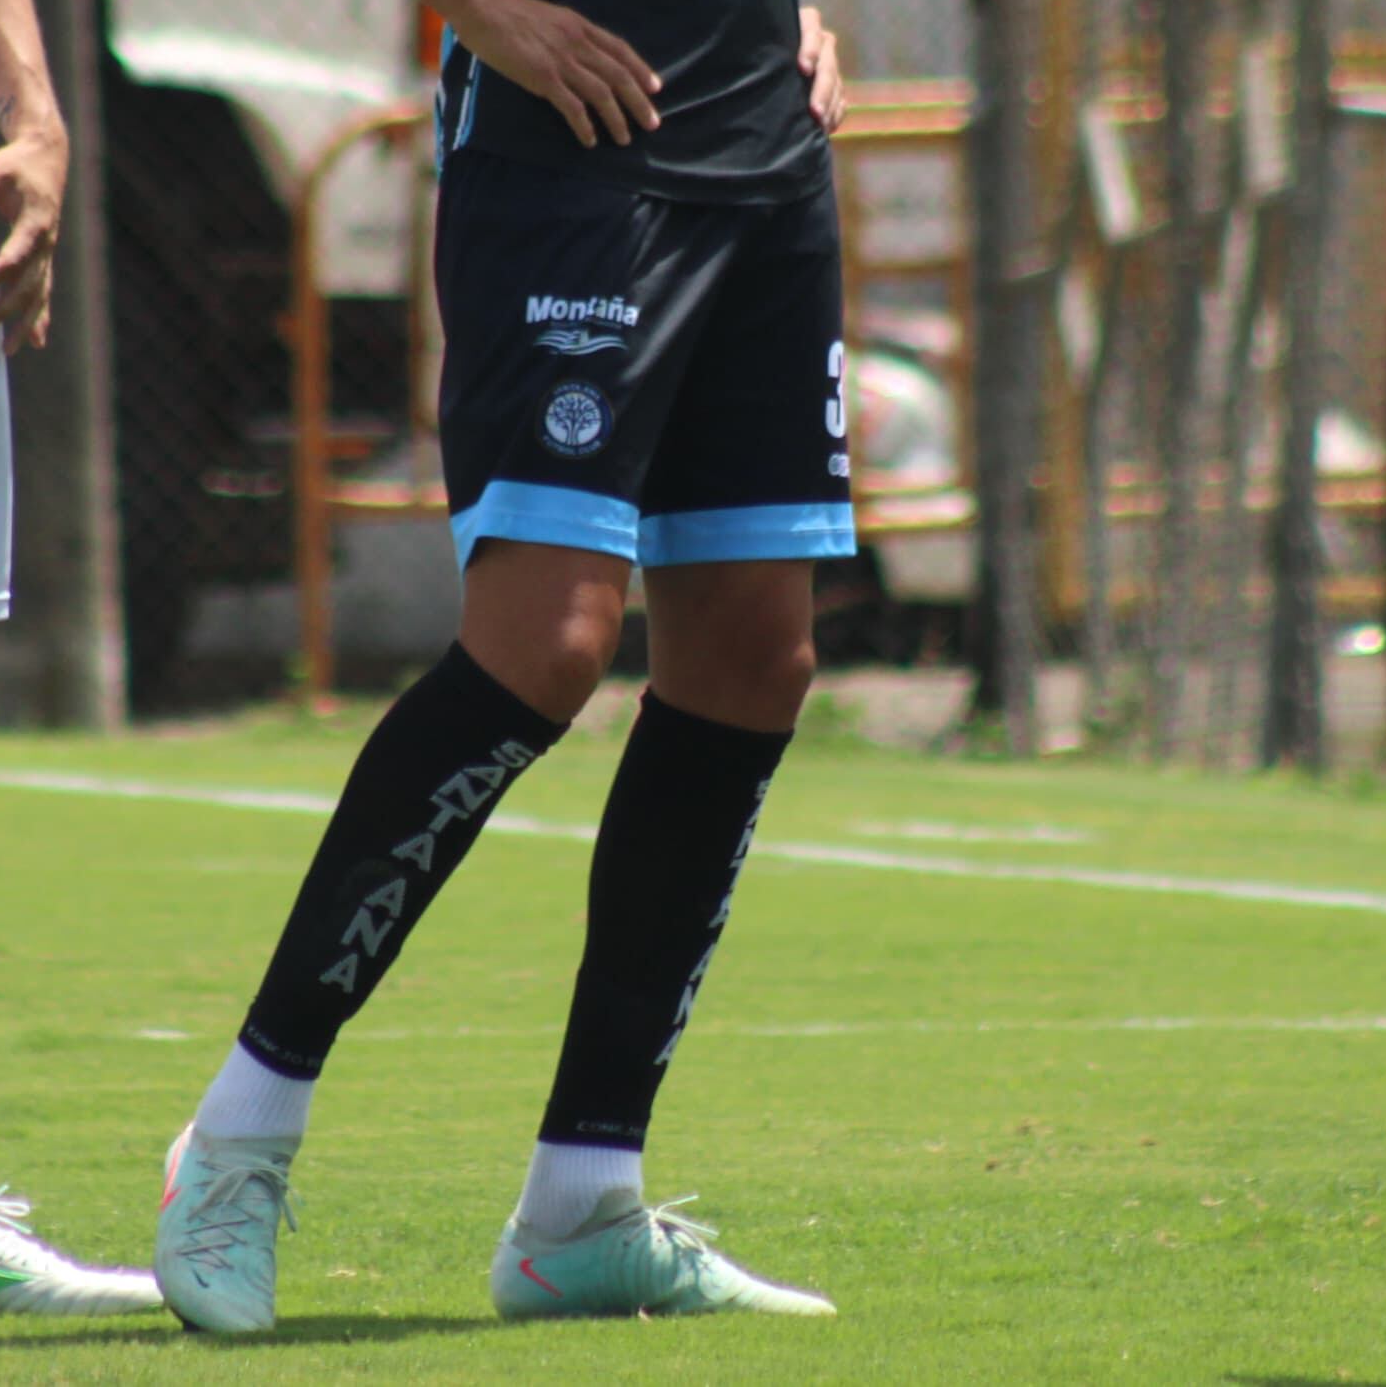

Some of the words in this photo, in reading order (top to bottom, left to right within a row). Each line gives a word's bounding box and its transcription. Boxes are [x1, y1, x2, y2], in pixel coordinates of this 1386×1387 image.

[526, 296, 641, 326] Montaña
[393, 740, 534, 873] SANTA
[319, 877, 408, 993] ANA
